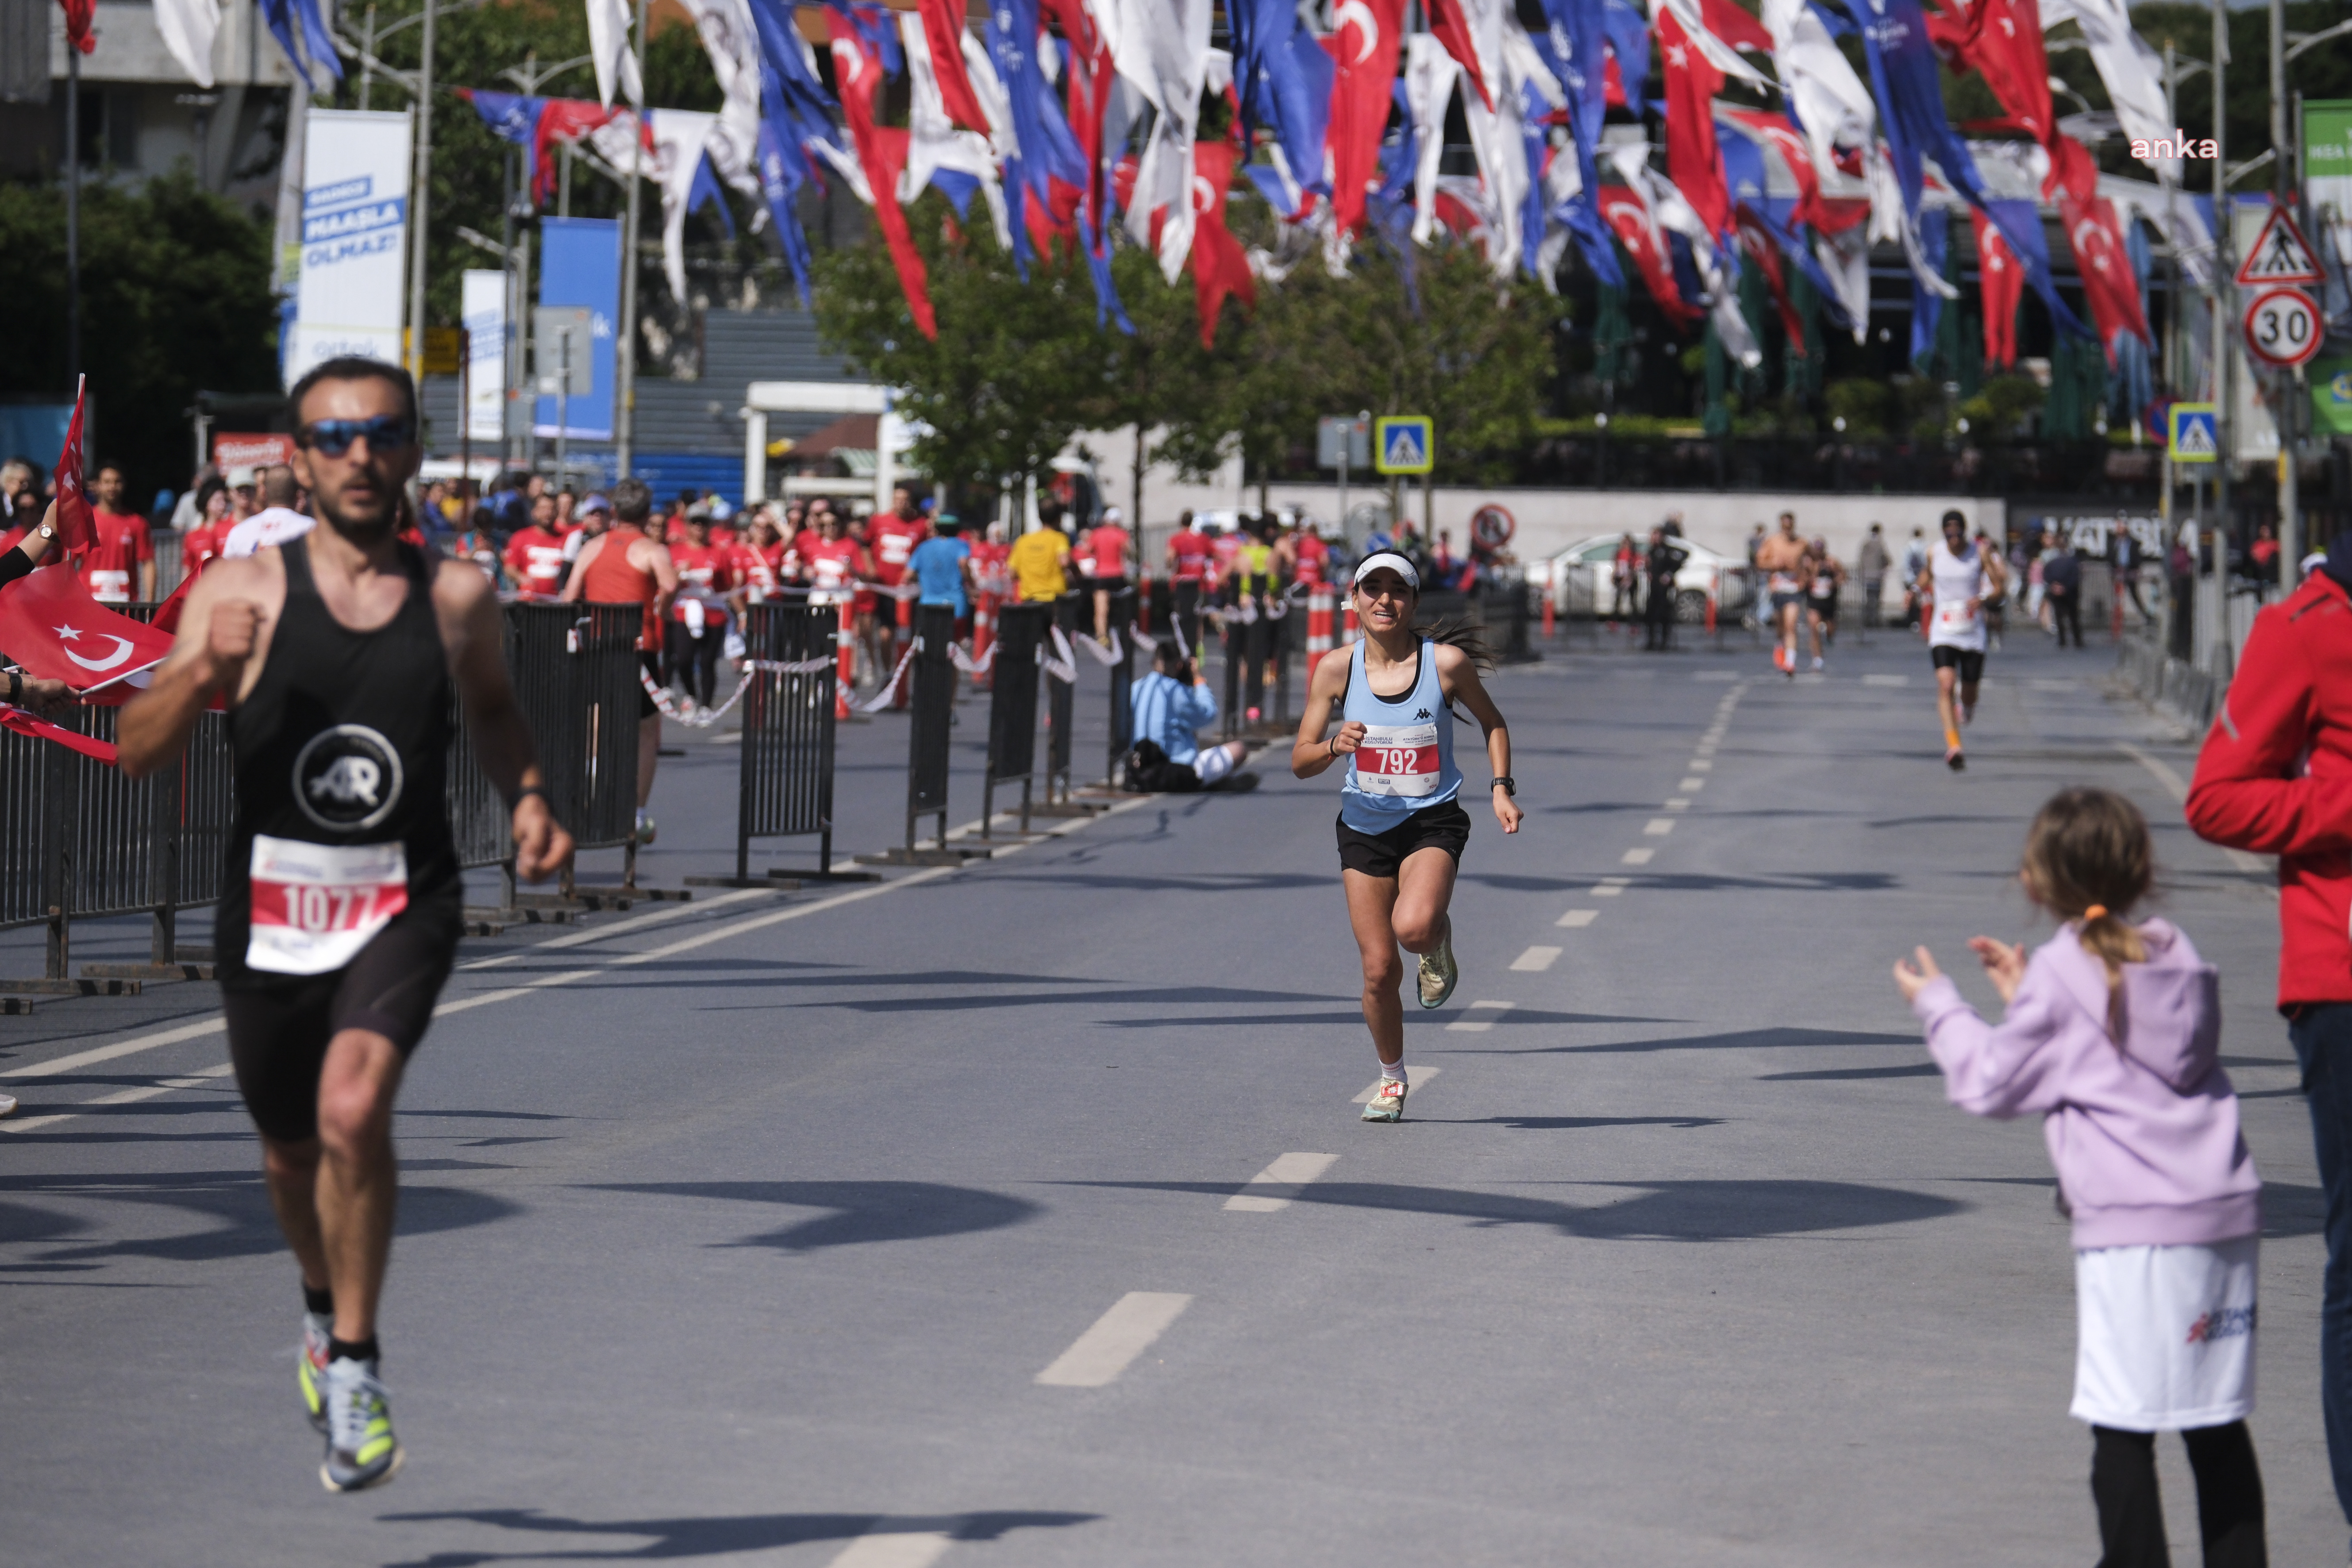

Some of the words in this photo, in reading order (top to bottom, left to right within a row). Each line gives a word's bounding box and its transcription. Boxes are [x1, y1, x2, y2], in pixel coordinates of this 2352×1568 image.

[305, 202, 400, 242] MAAŞLA
[2261, 310, 2308, 345] 30
[1376, 749, 1417, 774] 792
[282, 885, 379, 933] 1077
